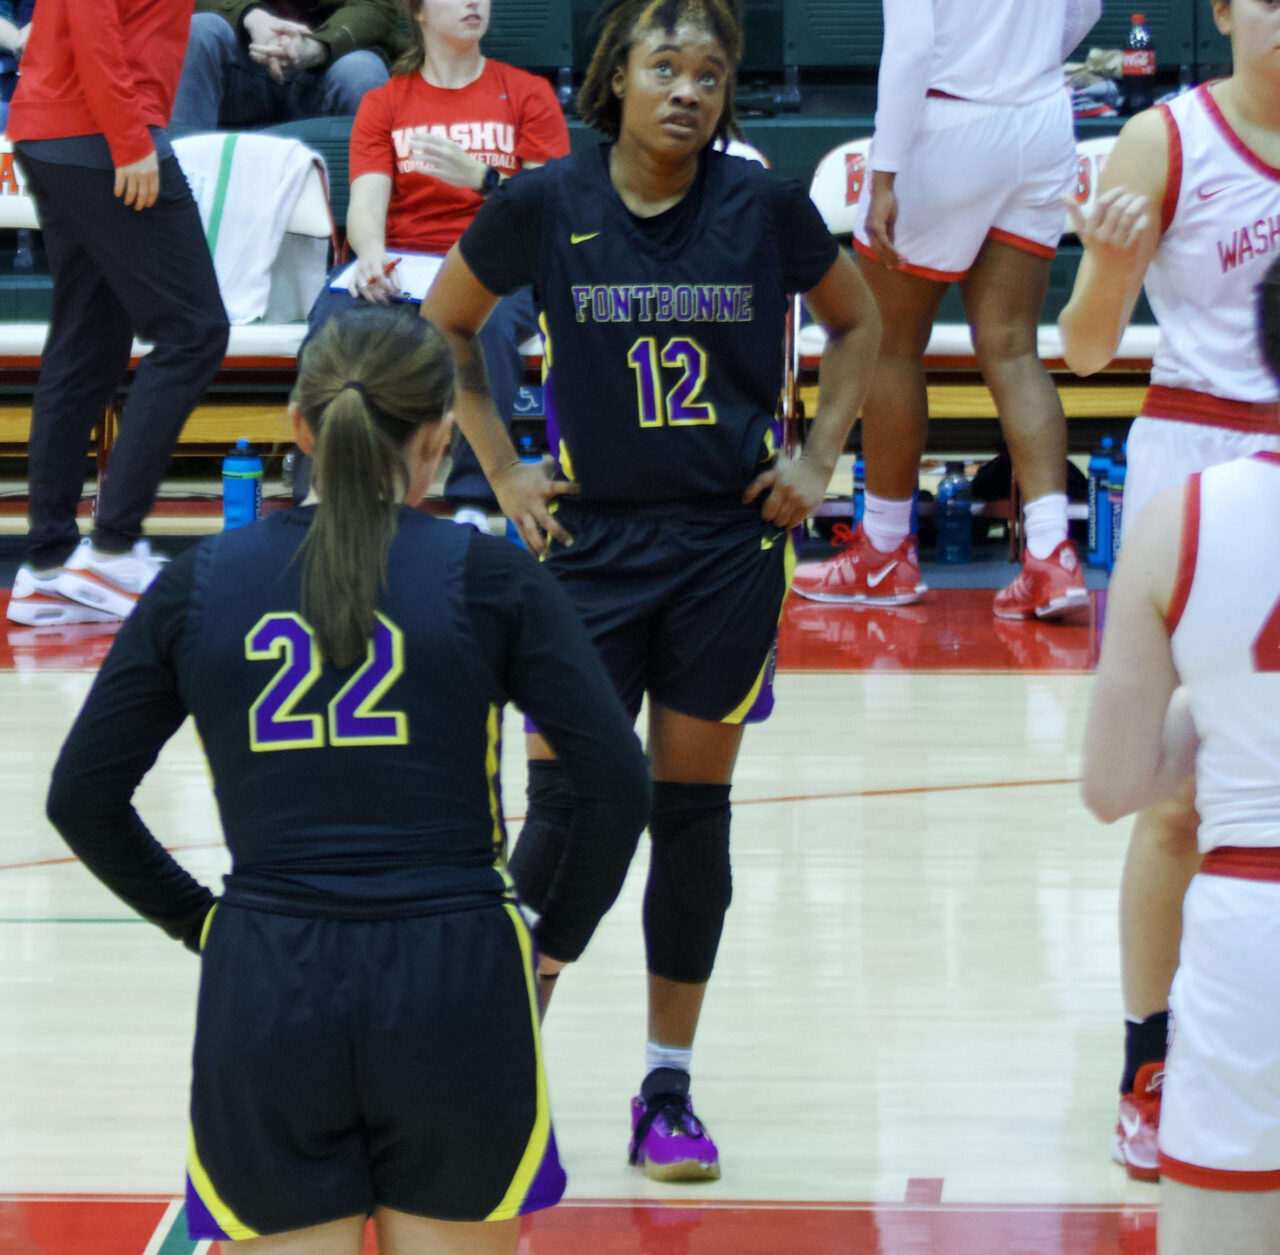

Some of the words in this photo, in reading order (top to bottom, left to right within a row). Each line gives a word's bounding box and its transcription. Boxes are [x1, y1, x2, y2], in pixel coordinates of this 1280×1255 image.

[571, 285, 754, 322] FONTBONNE
[627, 337, 717, 428] 12
[245, 610, 410, 752] 22
